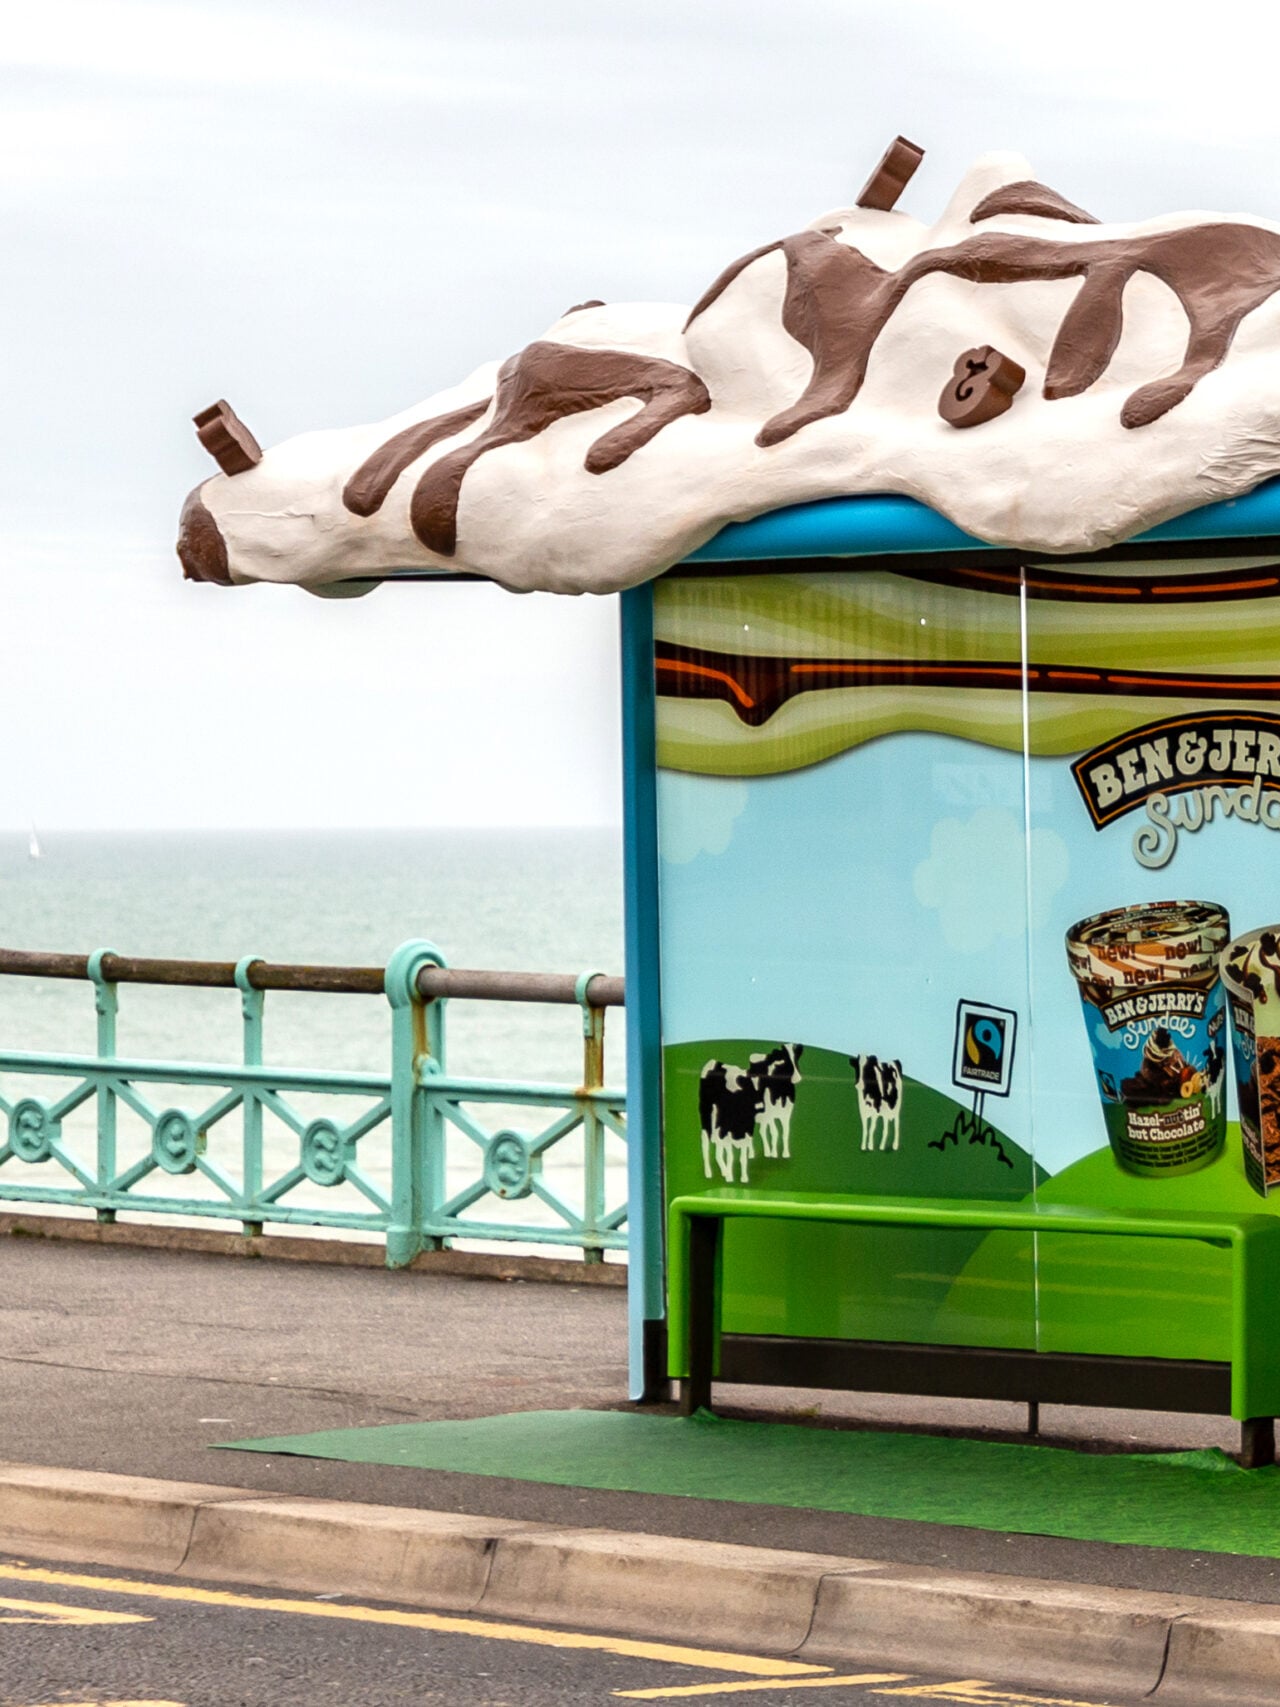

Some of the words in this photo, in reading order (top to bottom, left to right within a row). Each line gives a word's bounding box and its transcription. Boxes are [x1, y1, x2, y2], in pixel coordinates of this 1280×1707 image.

[1097, 943, 1136, 963] new!
[1165, 935, 1202, 960] new!
[1123, 965, 1165, 986] new!
[1123, 1010, 1196, 1050] Sundae
[962, 1065, 1000, 1081] FAIRTRADE
[1127, 1125, 1150, 1141] but
[1149, 1118, 1206, 1141] Chocolate
